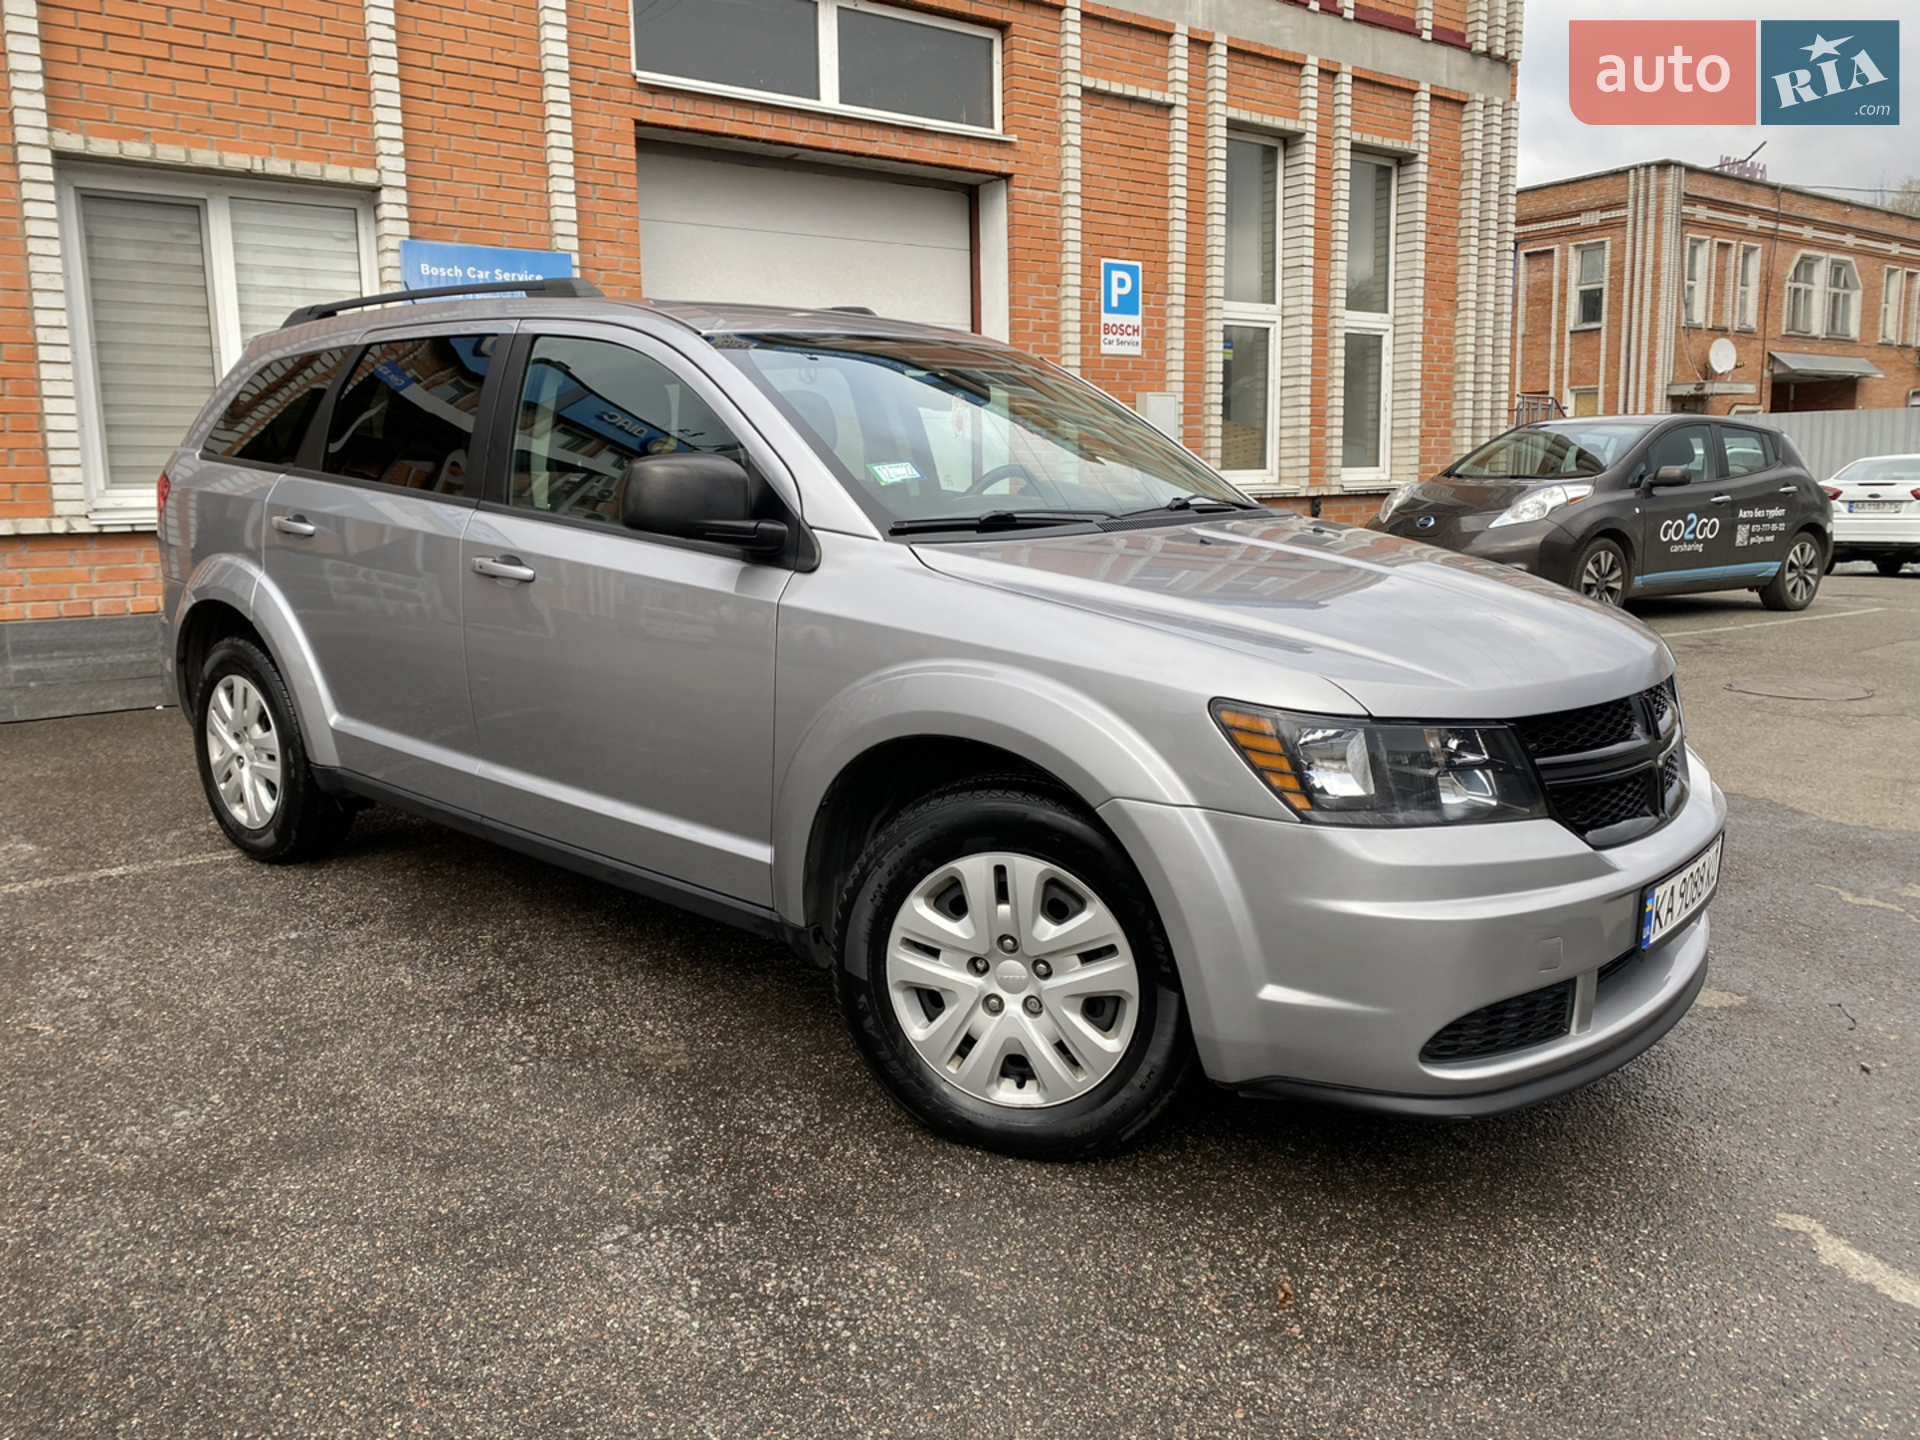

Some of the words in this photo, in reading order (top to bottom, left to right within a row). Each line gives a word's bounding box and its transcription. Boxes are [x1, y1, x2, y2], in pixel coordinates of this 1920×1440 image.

[420, 263, 462, 277] Bosch
[467, 267, 490, 279] Car
[494, 269, 543, 281] Service
[1111, 270, 1132, 307] P
[1103, 323, 1139, 336] BOSCH
[1103, 337, 1114, 345] Car
[1116, 338, 1139, 347] Service
[1738, 508, 1753, 518] Авто
[1754, 508, 1765, 518] без
[1660, 513, 1720, 542] GO2GO
[1670, 542, 1704, 552] carsharing
[1653, 884, 1675, 934] KA
[1677, 861, 1706, 917] 9088
